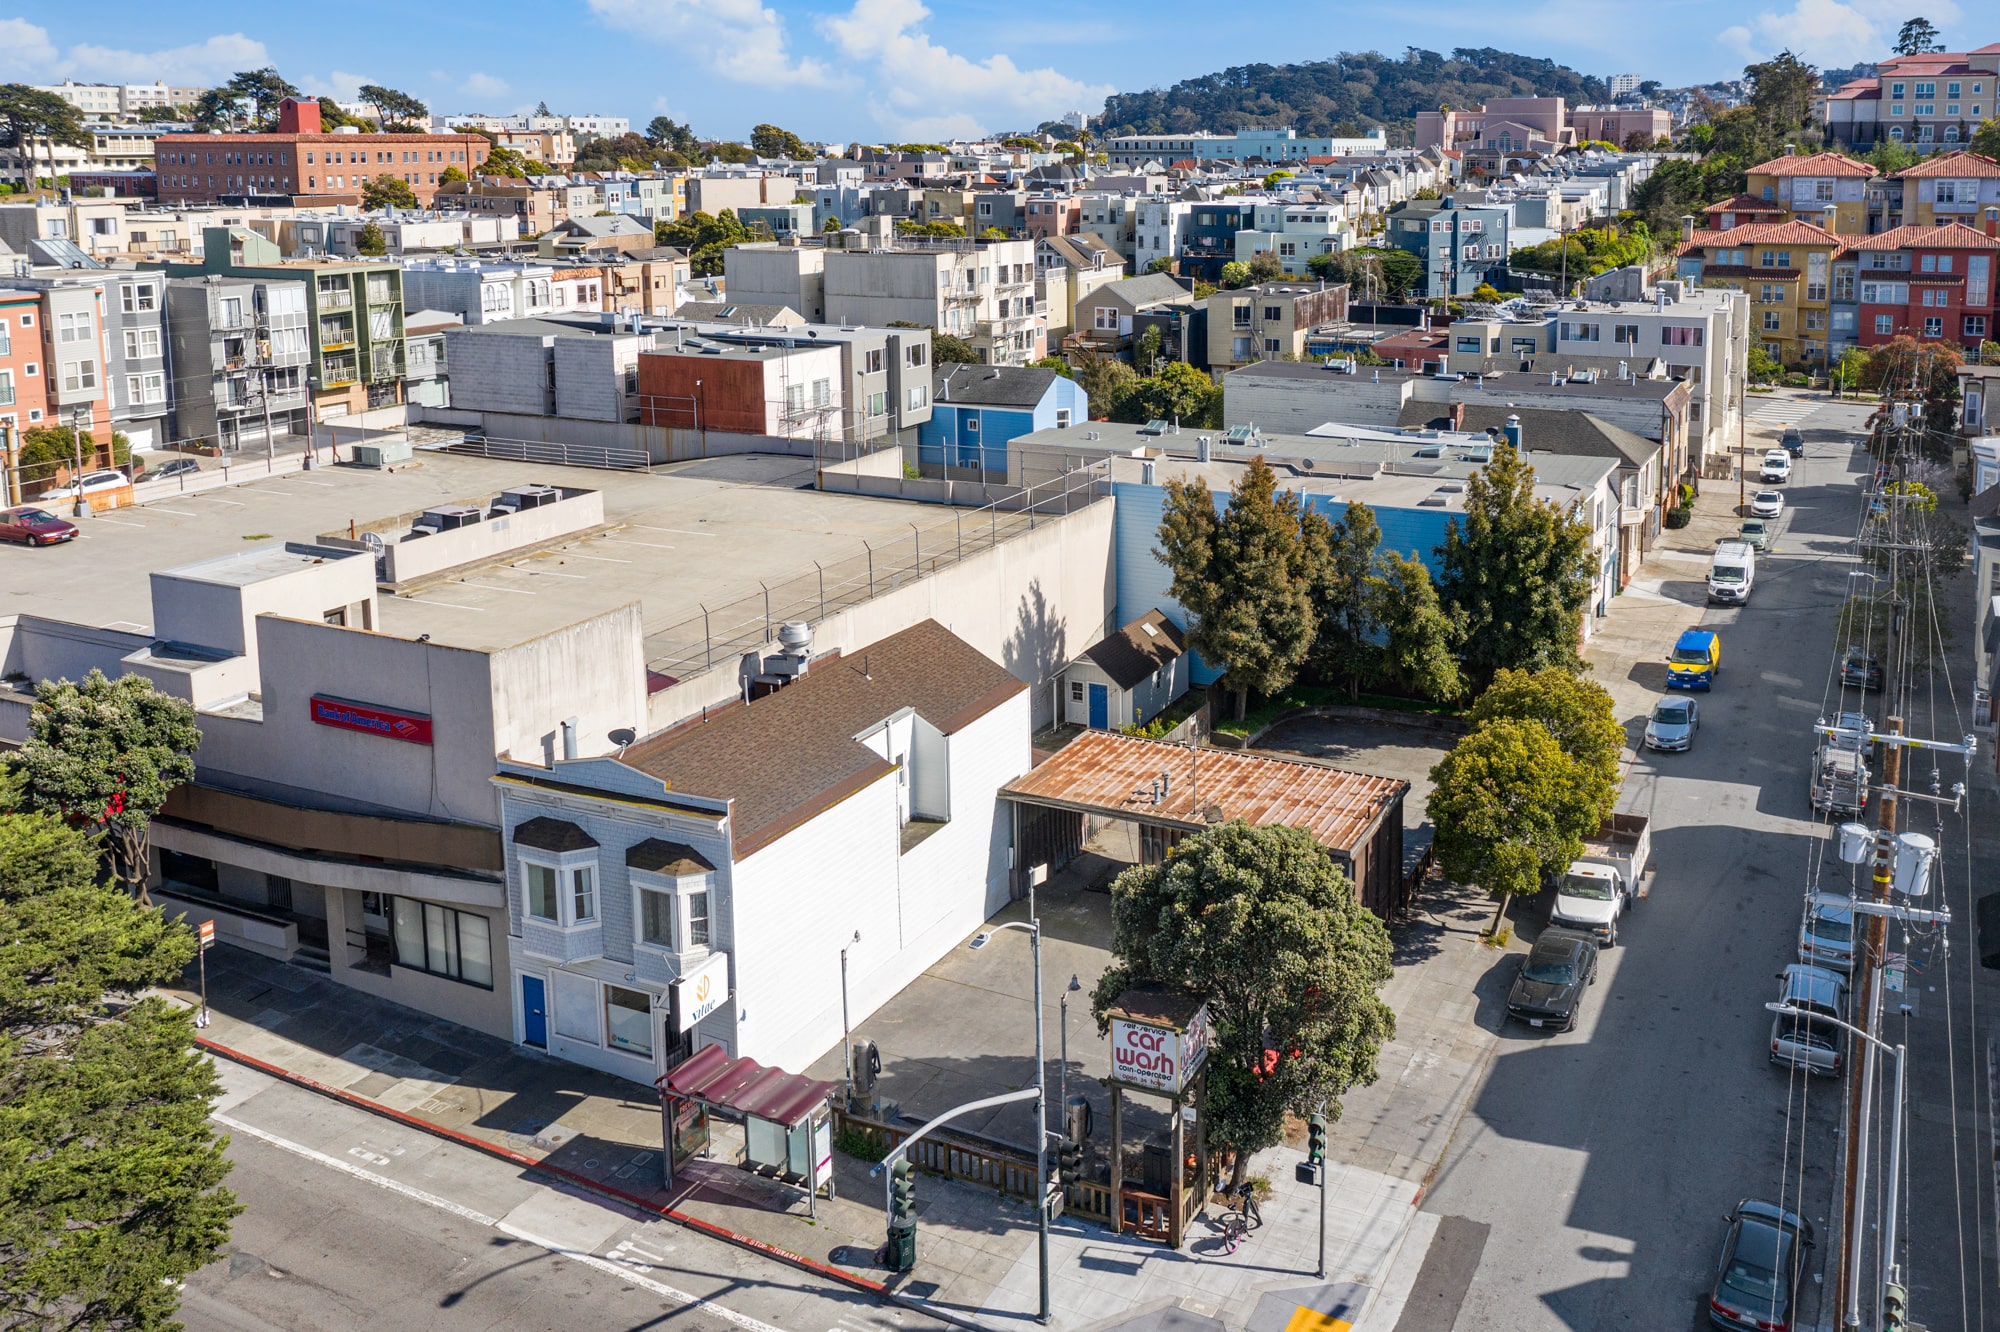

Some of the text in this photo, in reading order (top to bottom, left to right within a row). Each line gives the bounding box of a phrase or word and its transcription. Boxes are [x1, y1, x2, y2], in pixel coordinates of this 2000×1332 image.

[317, 704, 391, 731] Bank of America
[1127, 1031, 1165, 1053] car
[1116, 1047, 1174, 1076] wash
[1118, 1064, 1172, 1081] coin-operated
[1122, 1073, 1138, 1081] open
[732, 1232, 748, 1243] BUS
[749, 1239, 768, 1249] STOP
